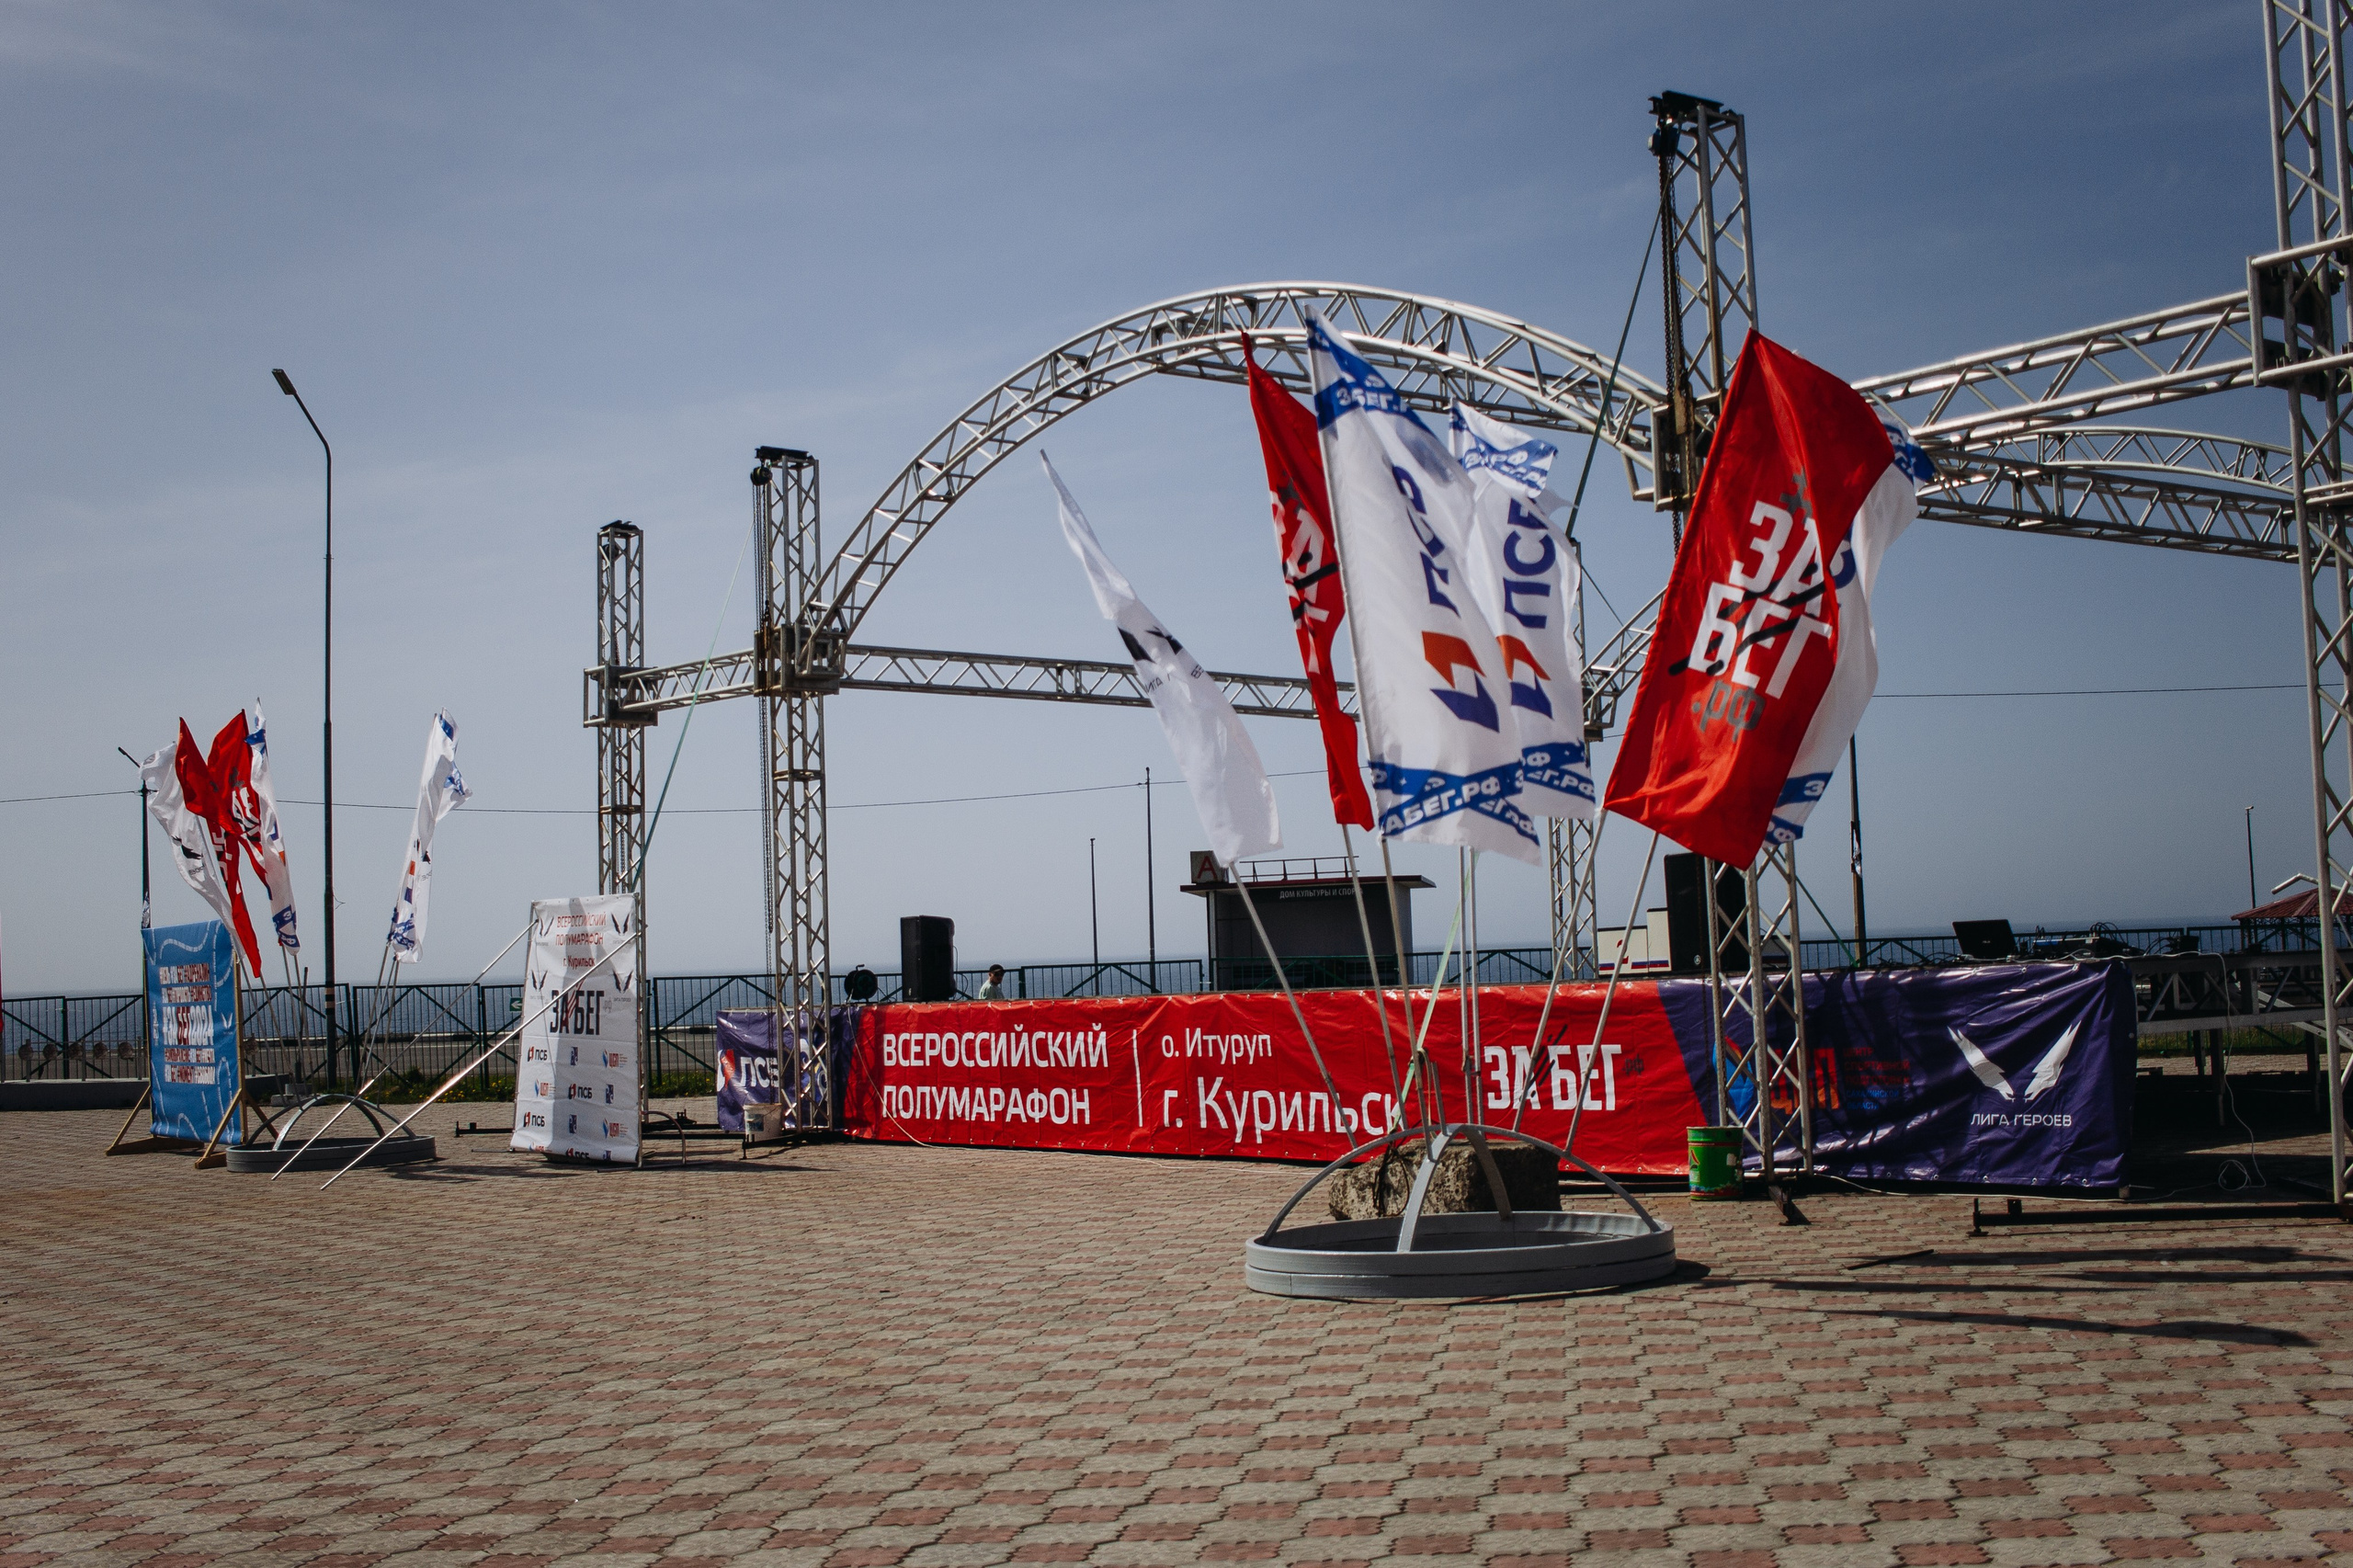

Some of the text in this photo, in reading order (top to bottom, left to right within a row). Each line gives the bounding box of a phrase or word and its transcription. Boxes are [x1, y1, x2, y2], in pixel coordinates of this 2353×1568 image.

[1688, 581, 1833, 699] БЕГ
[1279, 890, 1295, 900] ДОМ
[1296, 889, 1331, 898] КУЛЬТУРЫ
[1338, 888, 1364, 896] СПОР
[557, 911, 607, 928] ВСЕРОССИЙСКИЙ
[555, 932, 604, 946] ПОЛУМАРАФОН
[568, 955, 596, 970] Курильск
[883, 1023, 1108, 1068] ВСЕРОССИЙСКИЙ
[1186, 1028, 1272, 1064] Итуруп
[535, 1049, 548, 1061] ПСБ
[577, 1086, 593, 1099] ПСБ
[881, 1076, 1406, 1144] ПОЛУМАРАФОН г. Курильск
[531, 1115, 545, 1127] ПСБ
[1971, 1113, 2072, 1127] ЛИГА ГЕРОЕВ
